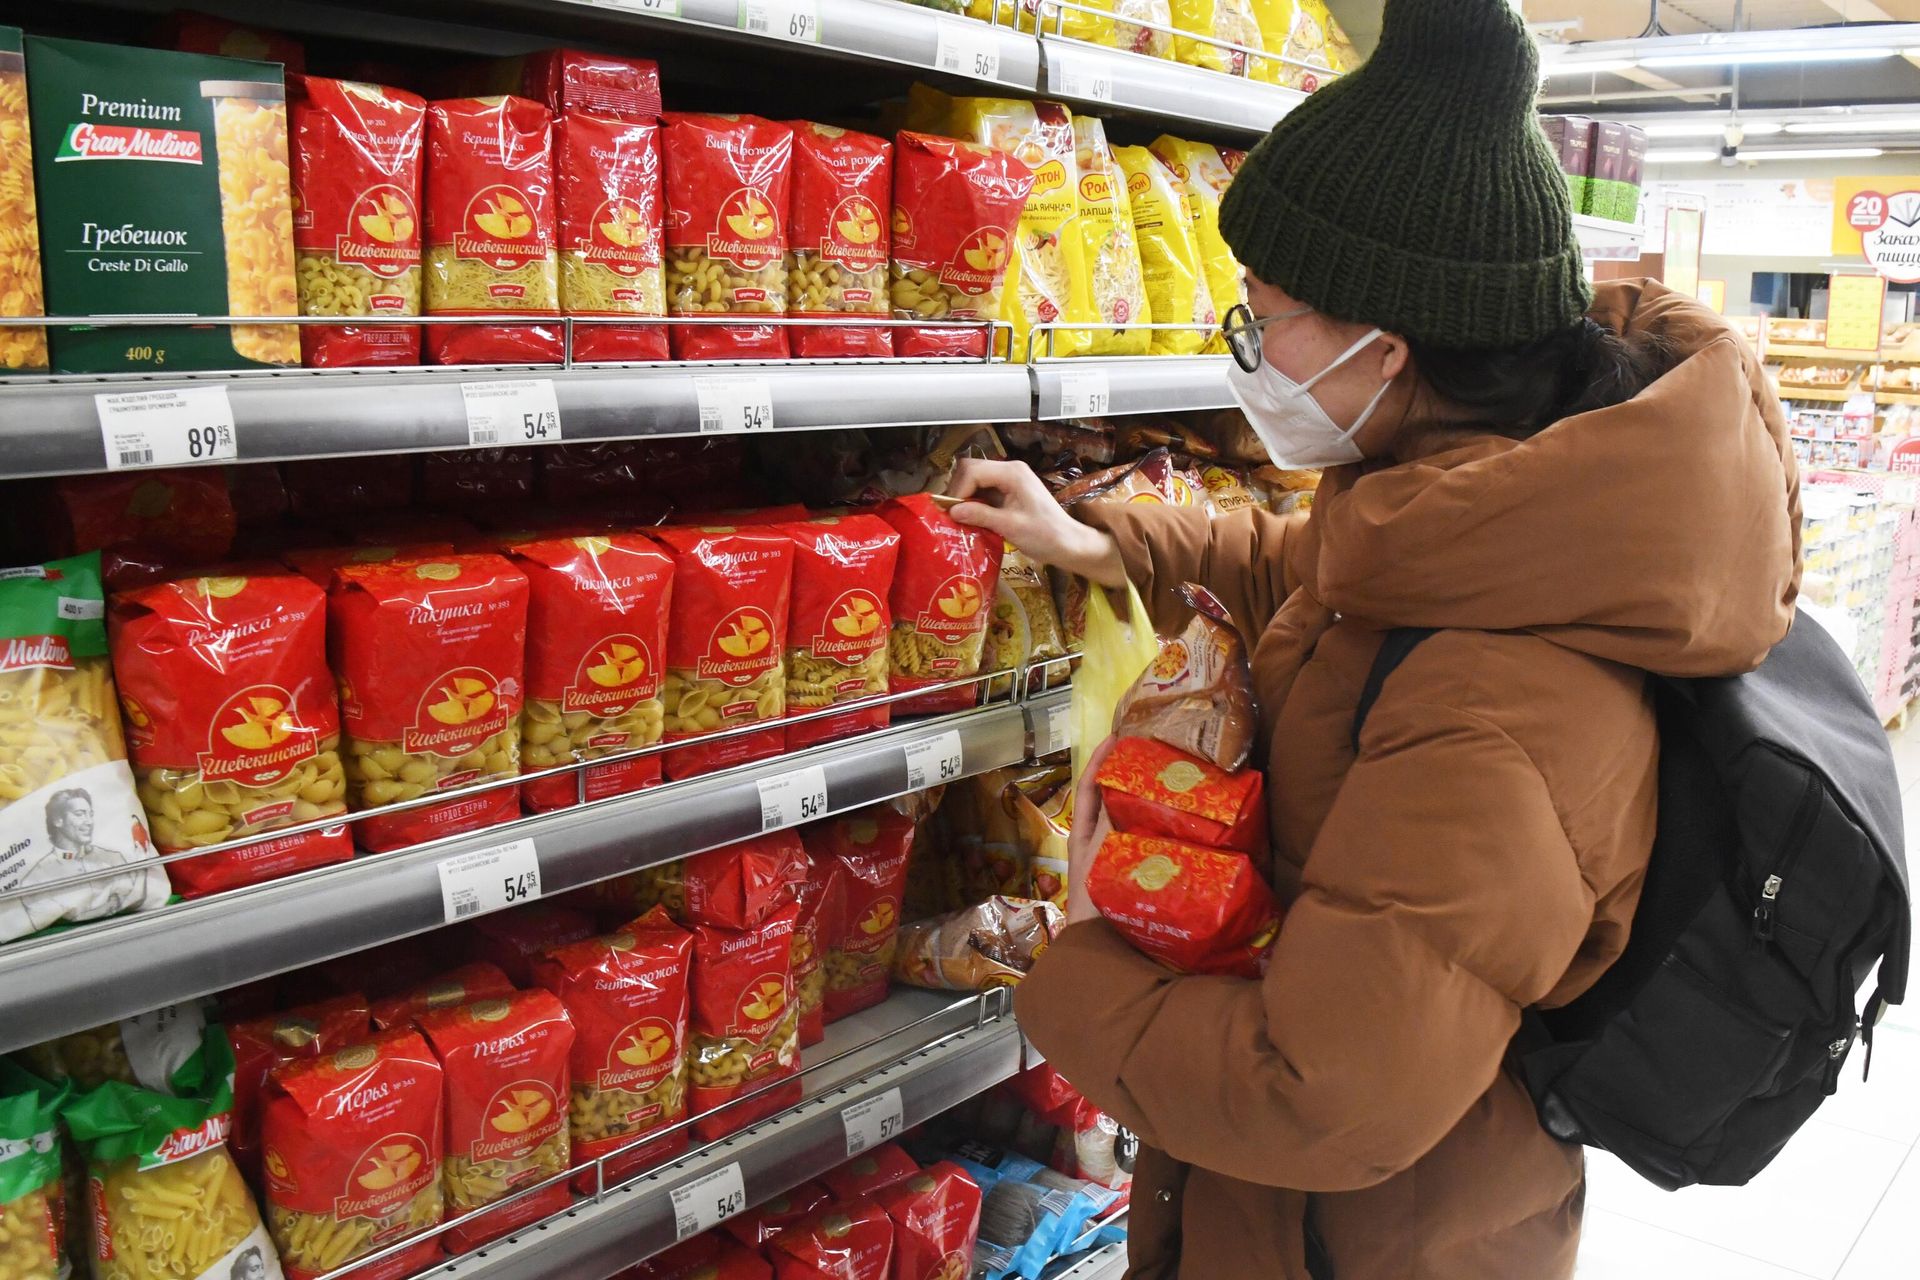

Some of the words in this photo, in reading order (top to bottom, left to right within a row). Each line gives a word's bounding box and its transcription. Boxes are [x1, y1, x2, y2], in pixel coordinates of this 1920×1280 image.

[789, 14, 807, 37] 69
[975, 54, 989, 75] 56
[81, 93, 181, 121] Premium
[70, 122, 126, 156] Gran
[124, 129, 199, 158] Mulino
[1853, 196, 1882, 215] 20
[82, 222, 187, 251] Гребешок
[457, 238, 545, 256] Шебекинские
[88, 258, 130, 272] Creste
[134, 258, 151, 272] Di
[154, 258, 188, 273] Gallo
[125, 347, 152, 361] 400
[1089, 394, 1101, 413] 51
[523, 413, 547, 439] 54
[744, 405, 762, 429] 54
[188, 426, 217, 458] 89
[217, 425, 230, 439] 95
[645, 573, 658, 582] 393
[290, 611, 305, 622] 393
[408, 602, 483, 627] Ракушка
[497, 600, 510, 610] 393
[0, 635, 69, 669] Mulino
[701, 653, 778, 674] Шебекинские
[568, 683, 655, 707] Шебекинские
[408, 717, 505, 748] Шебекинские
[203, 739, 313, 776] Шебекинские
[941, 757, 954, 778] 54
[429, 808, 462, 824] ТВЕРДОЕ
[464, 799, 488, 815] ЗЕРНО
[801, 795, 817, 818] 54
[236, 842, 276, 861] ТВЕРДОЕ
[279, 834, 305, 850] ЗЕРНО
[504, 874, 527, 902] 54
[526, 871, 535, 882] 95
[721, 933, 758, 955] Витой
[760, 922, 793, 949] рожок
[473, 1032, 526, 1058] Перья
[337, 1082, 389, 1116] Перья
[880, 1116, 895, 1138] 57
[340, 1168, 433, 1215] Шебекинские
[718, 1194, 735, 1218] 54
